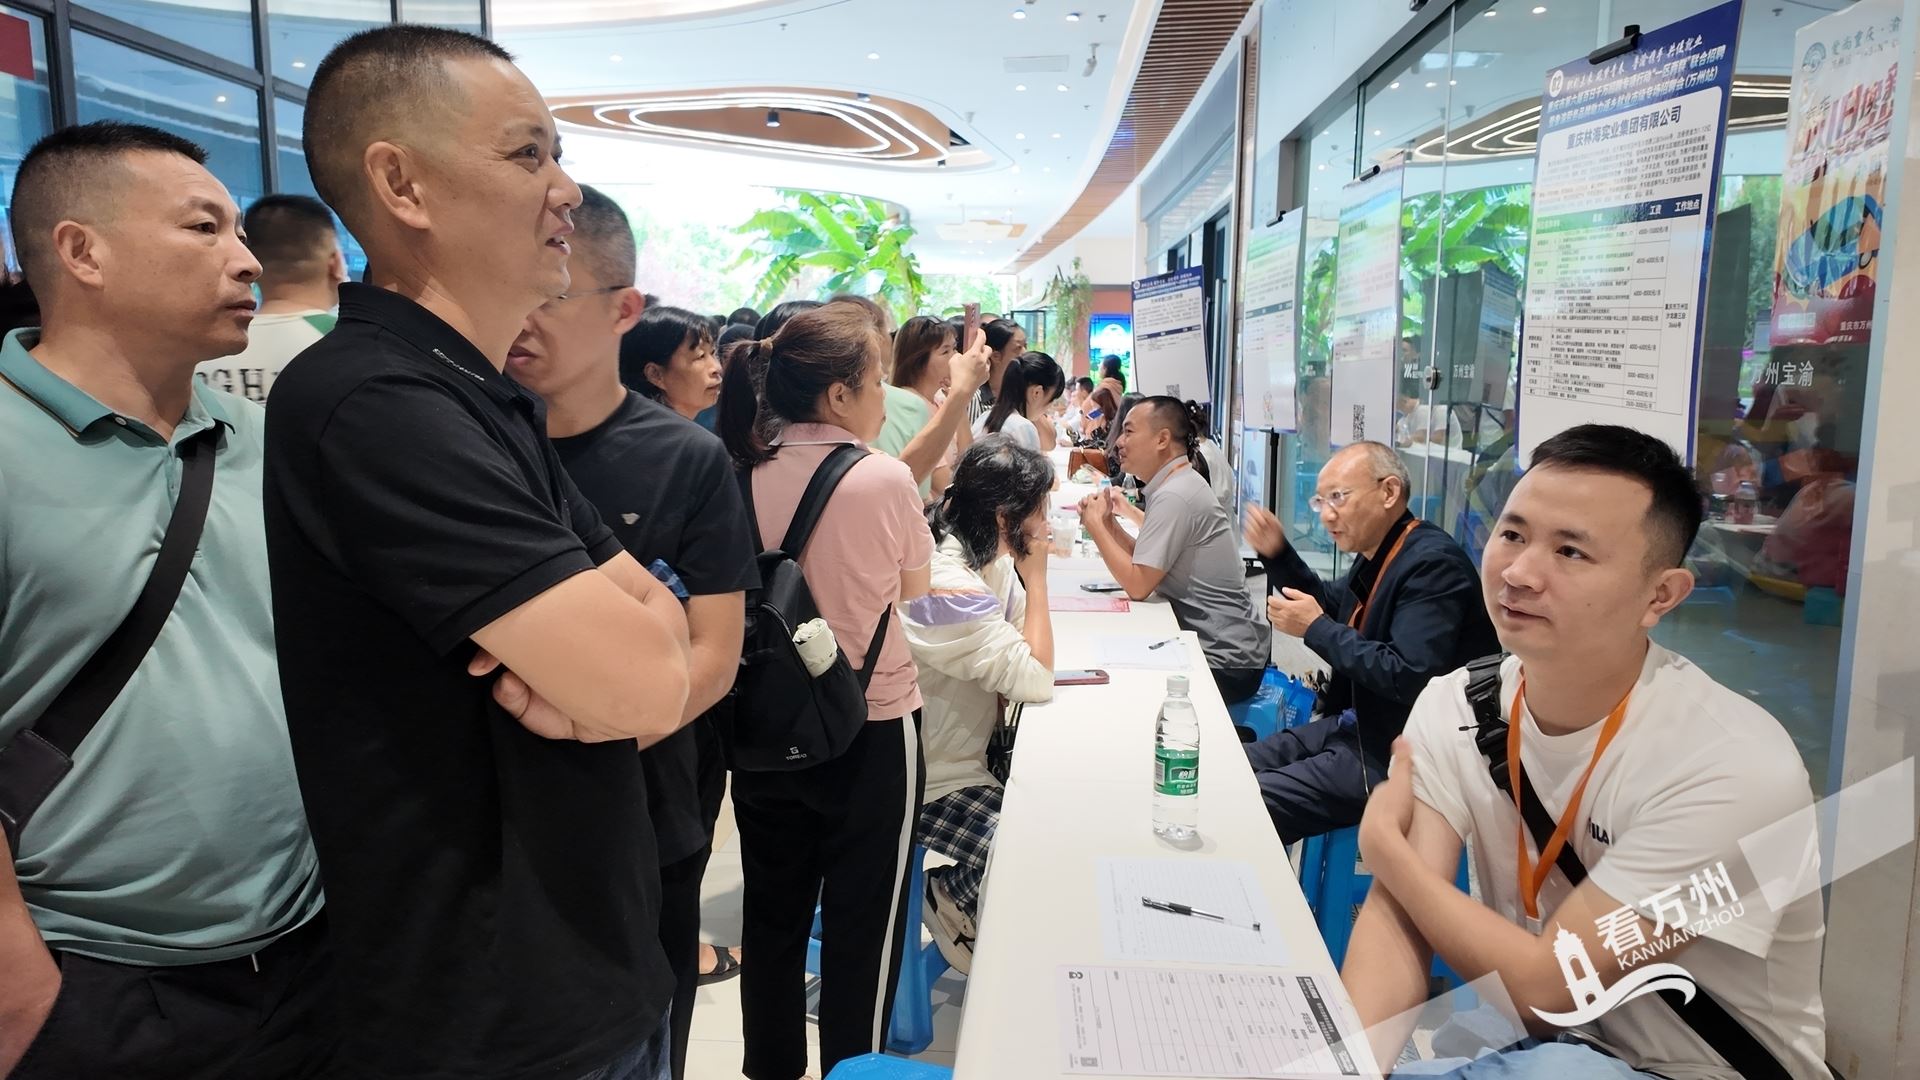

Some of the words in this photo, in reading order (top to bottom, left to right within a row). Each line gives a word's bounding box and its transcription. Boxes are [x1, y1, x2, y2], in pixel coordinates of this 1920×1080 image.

[1566, 105, 1682, 150] 重庆林海实业集团有限公司
[1649, 204, 1662, 216] 工资
[1674, 199, 1700, 213] 工作地点
[1750, 360, 1815, 387] 万州宝渝
